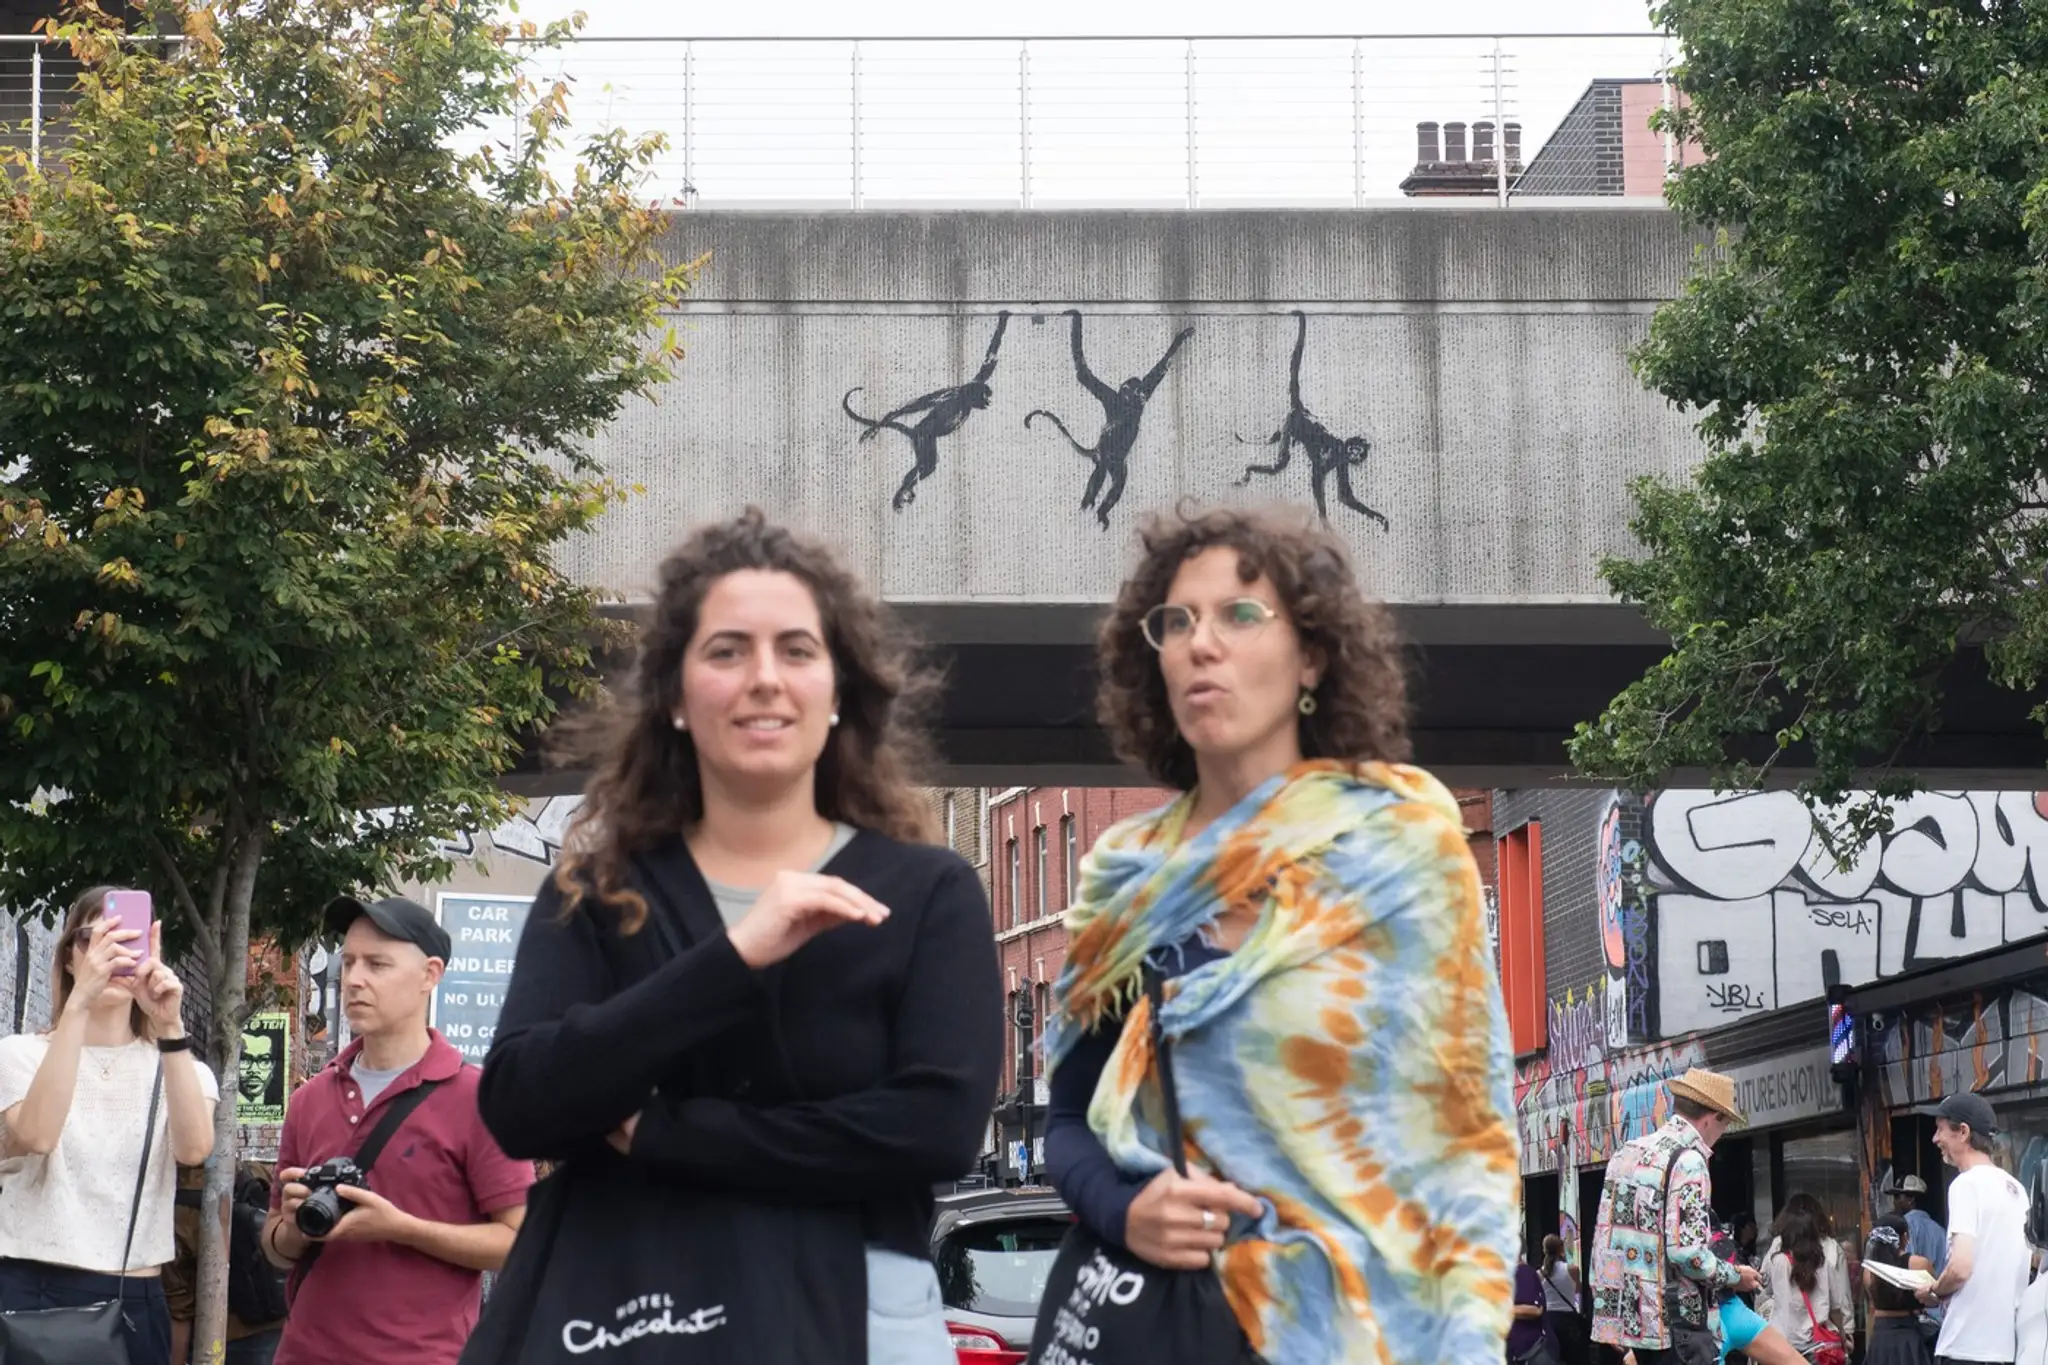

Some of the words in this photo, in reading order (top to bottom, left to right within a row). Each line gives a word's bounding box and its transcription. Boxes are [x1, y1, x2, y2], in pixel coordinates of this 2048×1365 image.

[468, 906, 509, 921] CAR
[460, 927, 513, 943] PARK
[483, 958, 516, 975] LEF
[444, 992, 468, 1006] NO
[446, 1023, 473, 1038] NO
[615, 1293, 675, 1321] HOTEL
